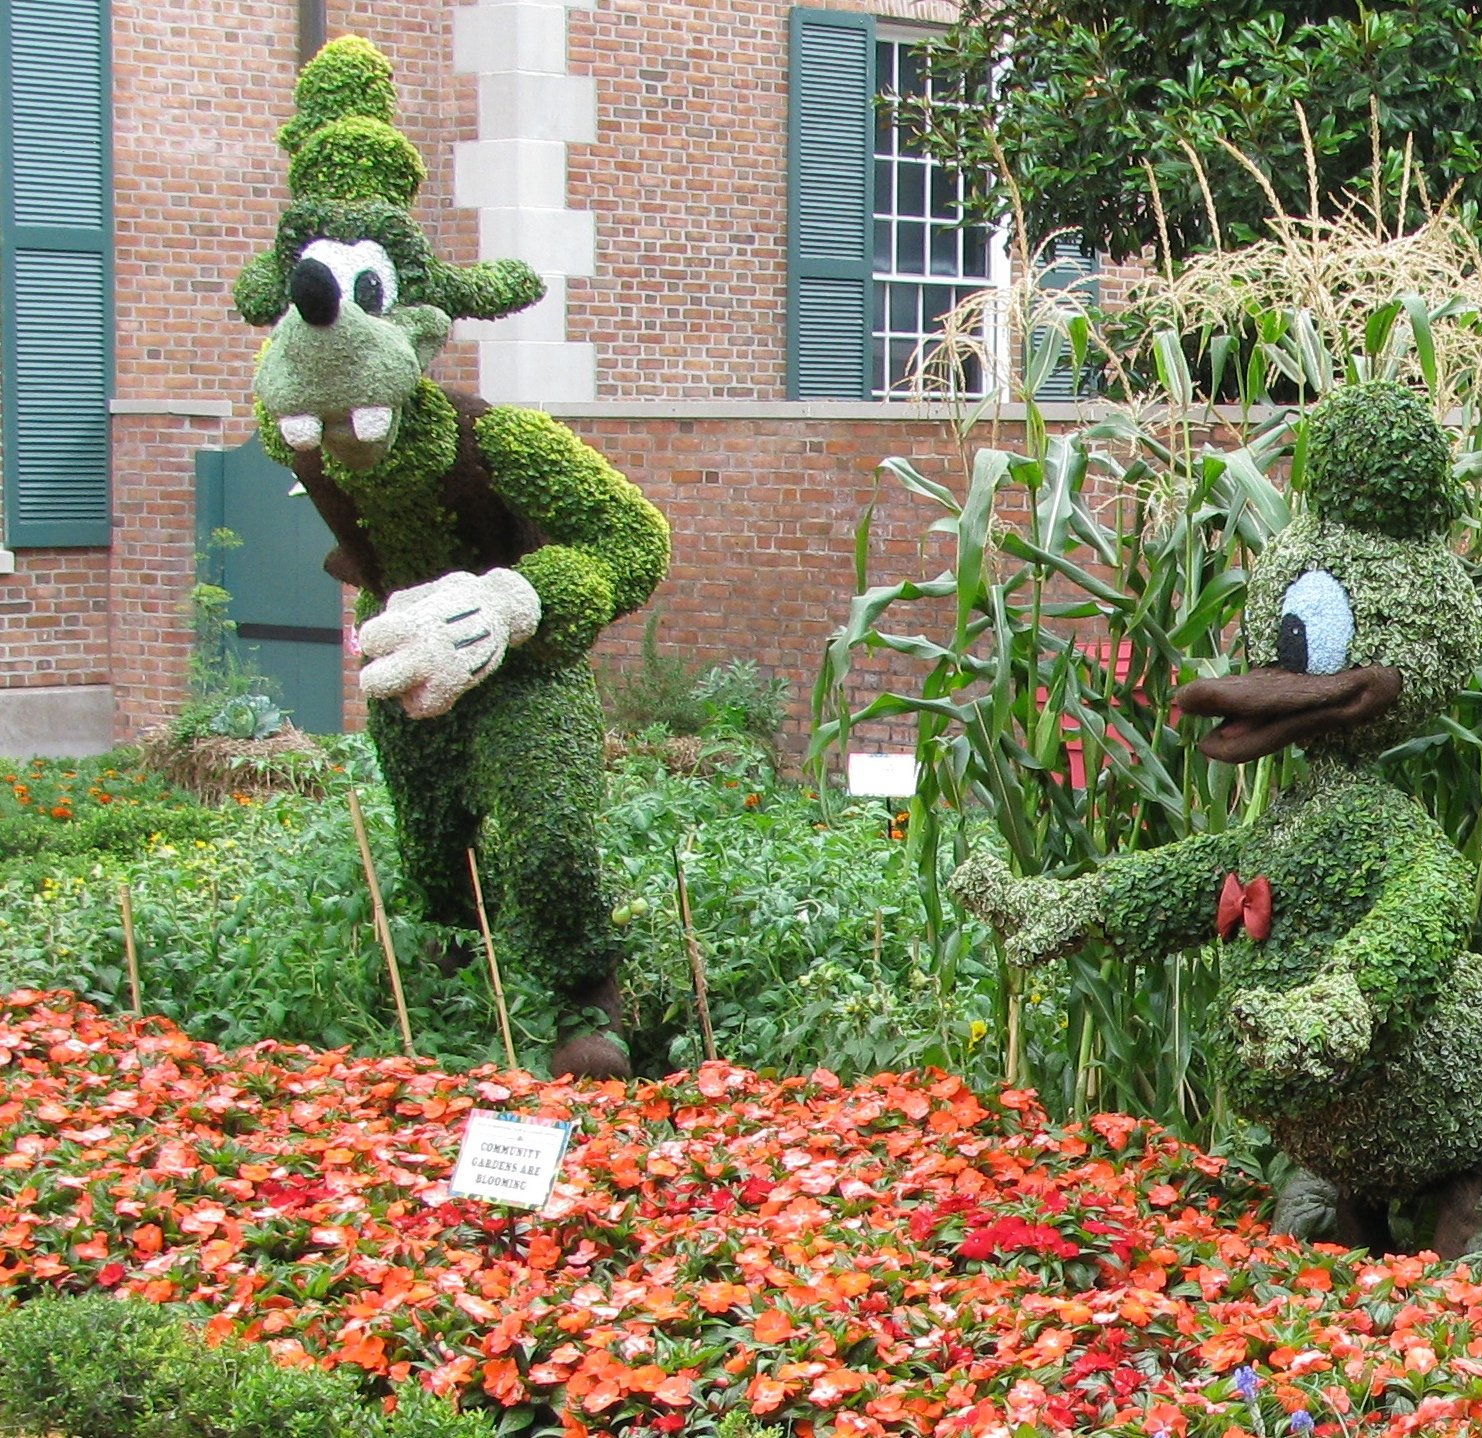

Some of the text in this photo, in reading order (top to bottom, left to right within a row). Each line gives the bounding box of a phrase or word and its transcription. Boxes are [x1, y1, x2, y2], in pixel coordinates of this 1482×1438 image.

[480, 1141, 542, 1160] COMMUNITY
[471, 1156, 542, 1176] GARDENS ARE
[475, 1173, 527, 1191] BLOOMING
